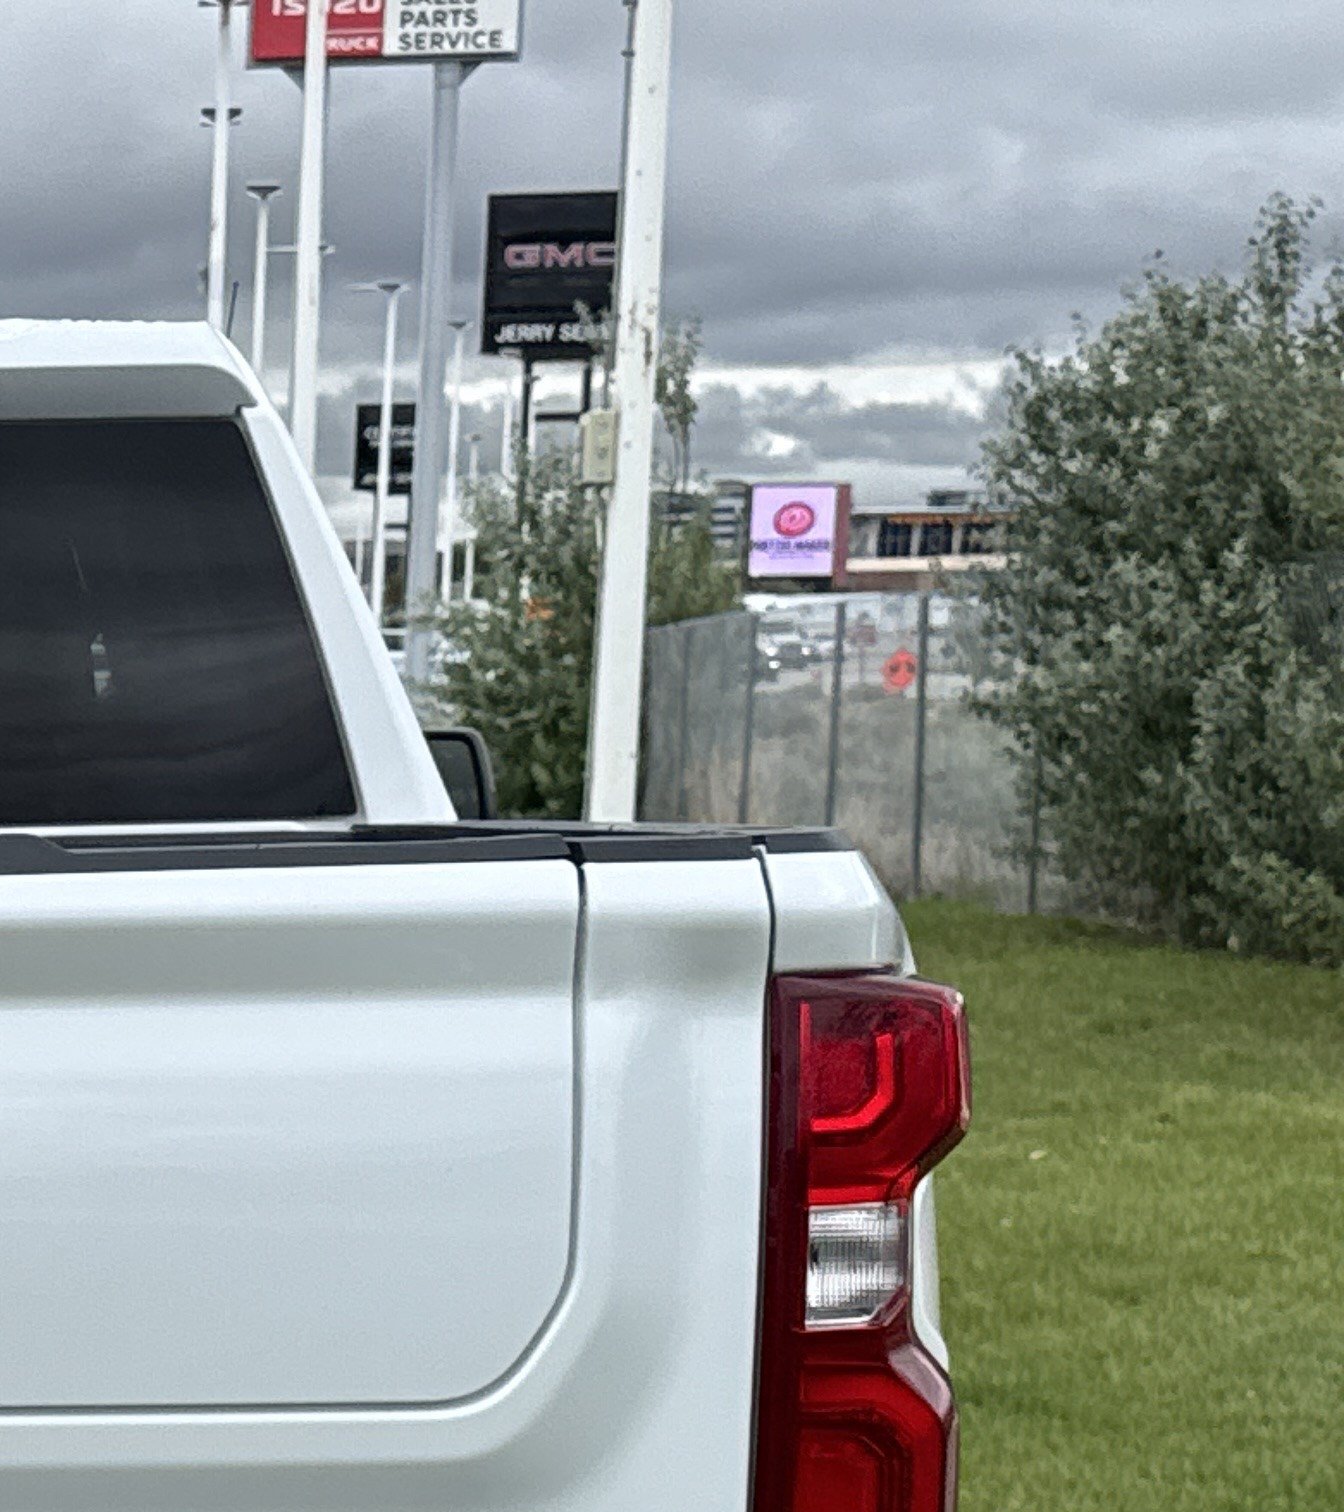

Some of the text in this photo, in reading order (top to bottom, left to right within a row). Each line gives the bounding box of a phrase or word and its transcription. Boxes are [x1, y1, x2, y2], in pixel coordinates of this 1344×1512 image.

[271, 0, 382, 16] ISZU
[399, 9, 478, 28] PARTS
[326, 36, 380, 52] RUCK
[399, 29, 503, 50] SERVICE
[504, 241, 616, 269] GMC
[494, 322, 557, 344] JERRY
